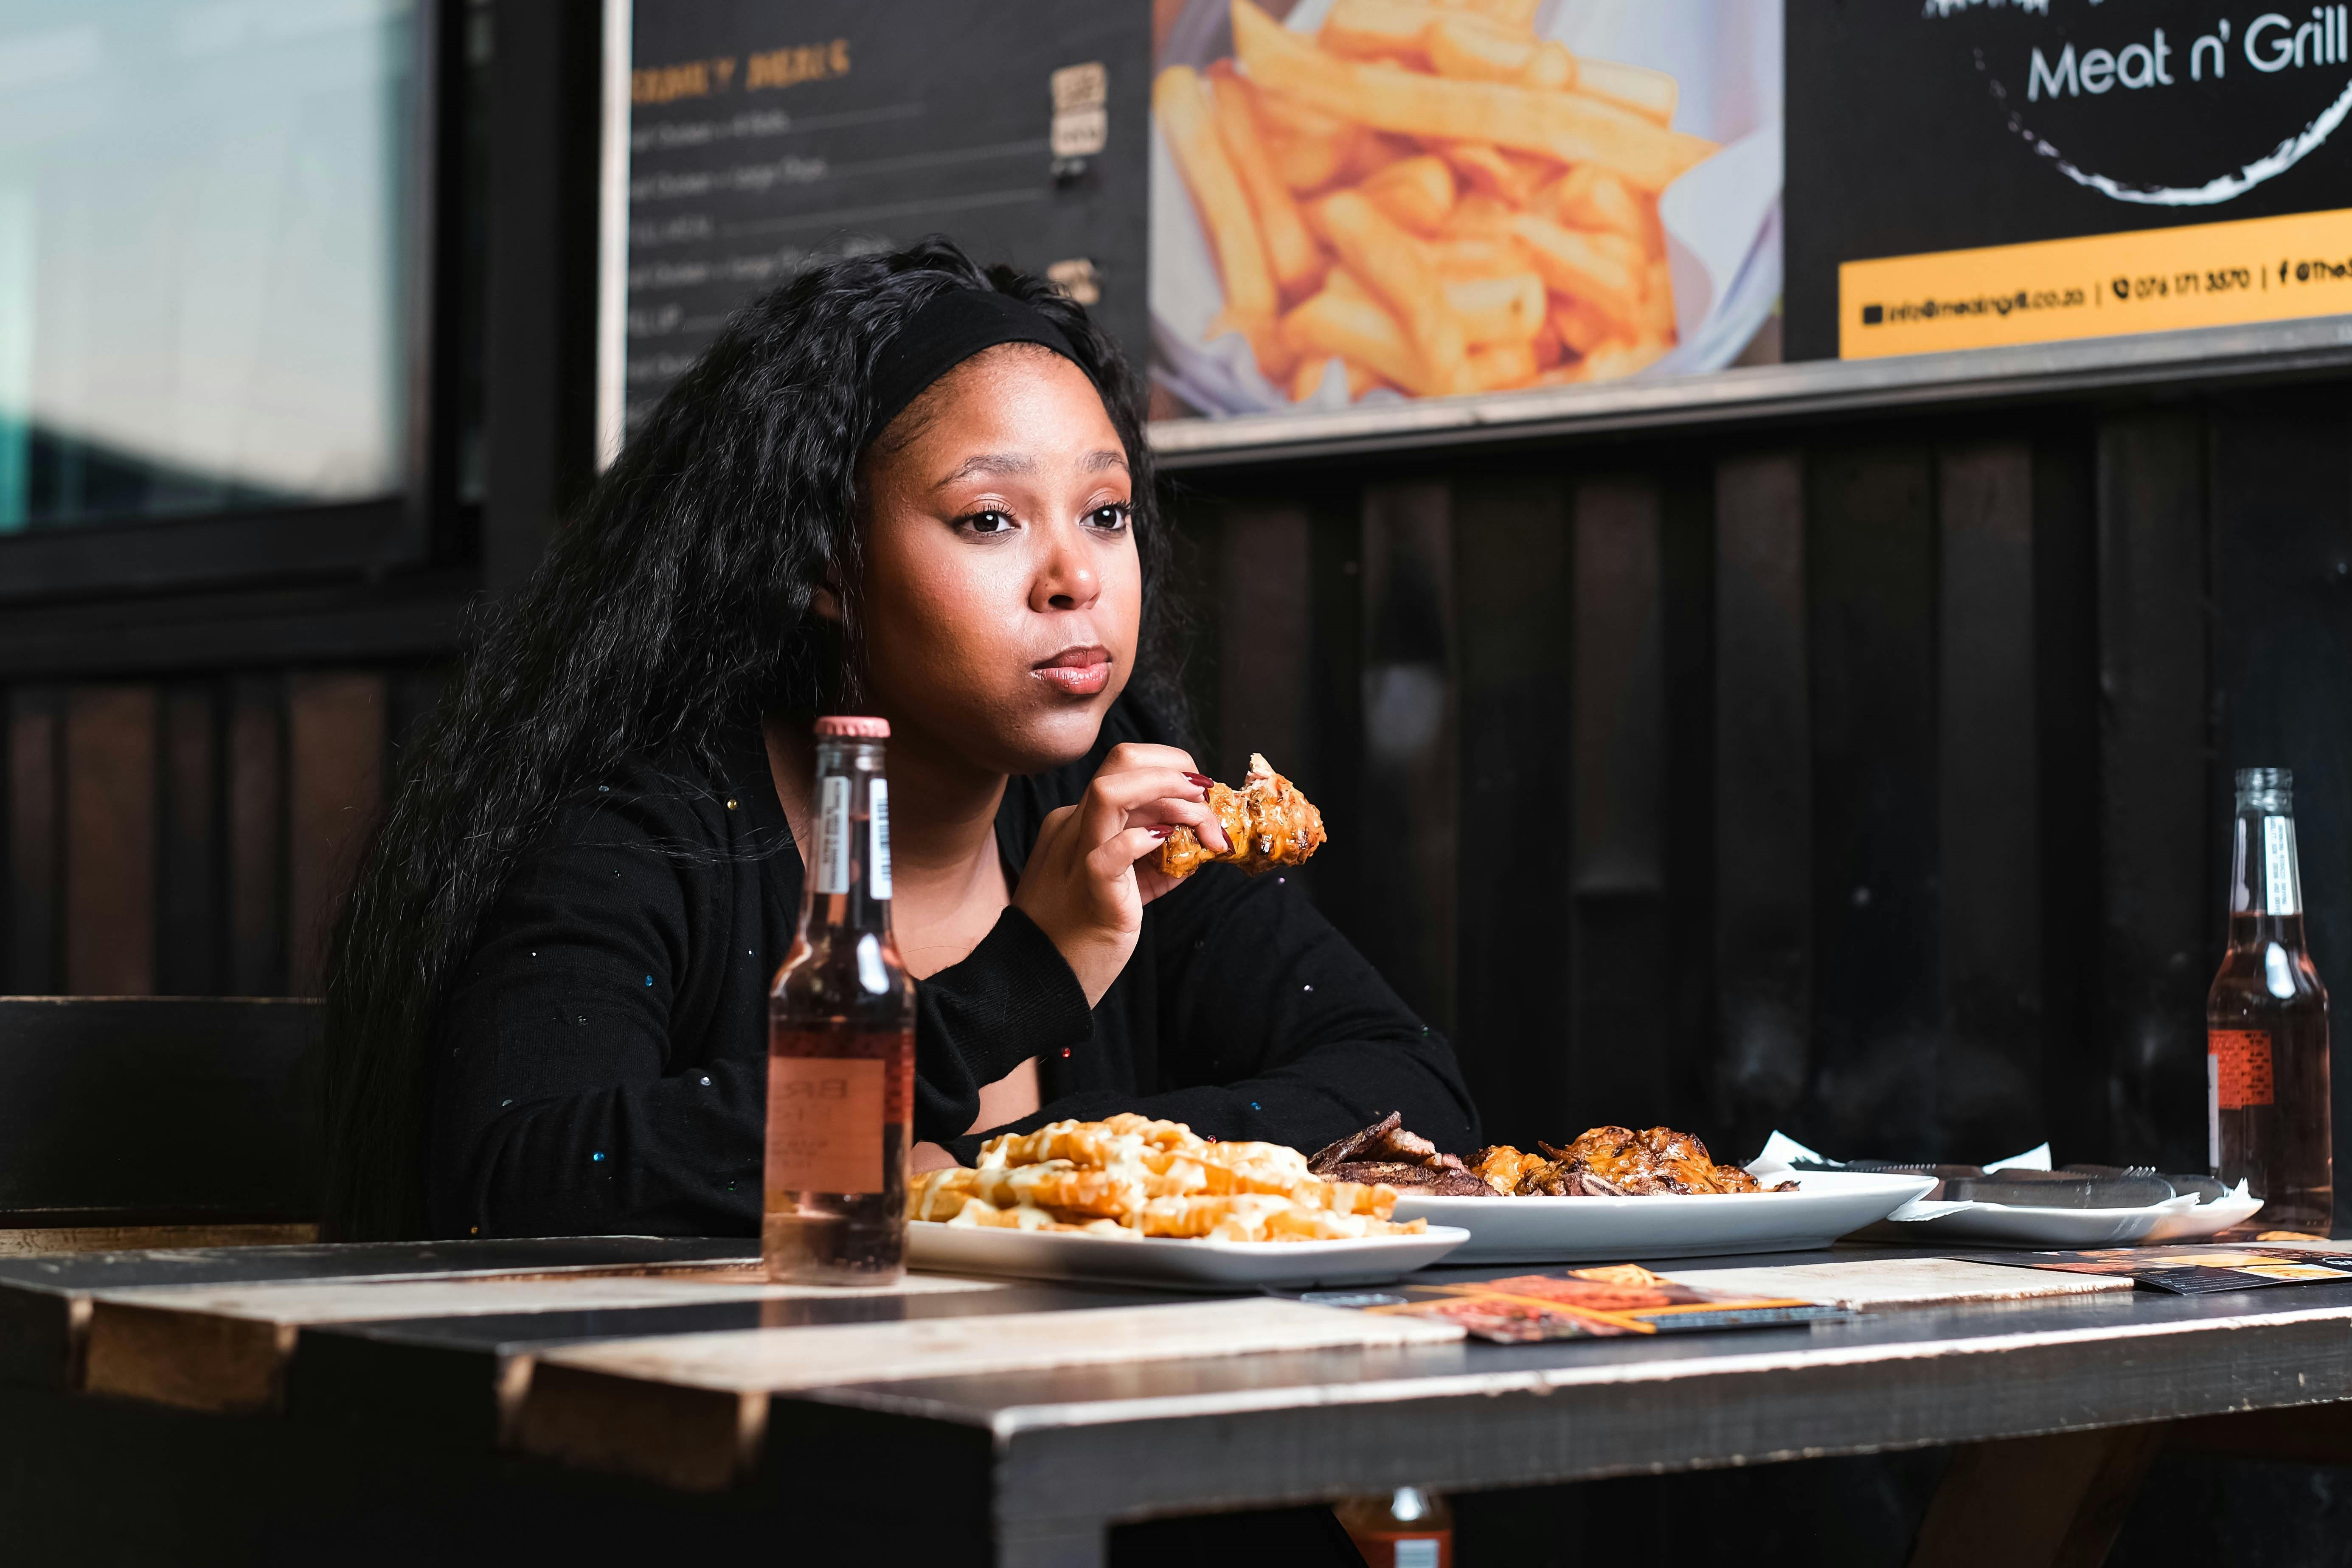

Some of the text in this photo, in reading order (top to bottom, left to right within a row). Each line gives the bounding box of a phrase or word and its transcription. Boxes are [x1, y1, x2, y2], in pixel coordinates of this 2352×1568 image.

[2027, 3, 2348, 102] Meat n' Grill
